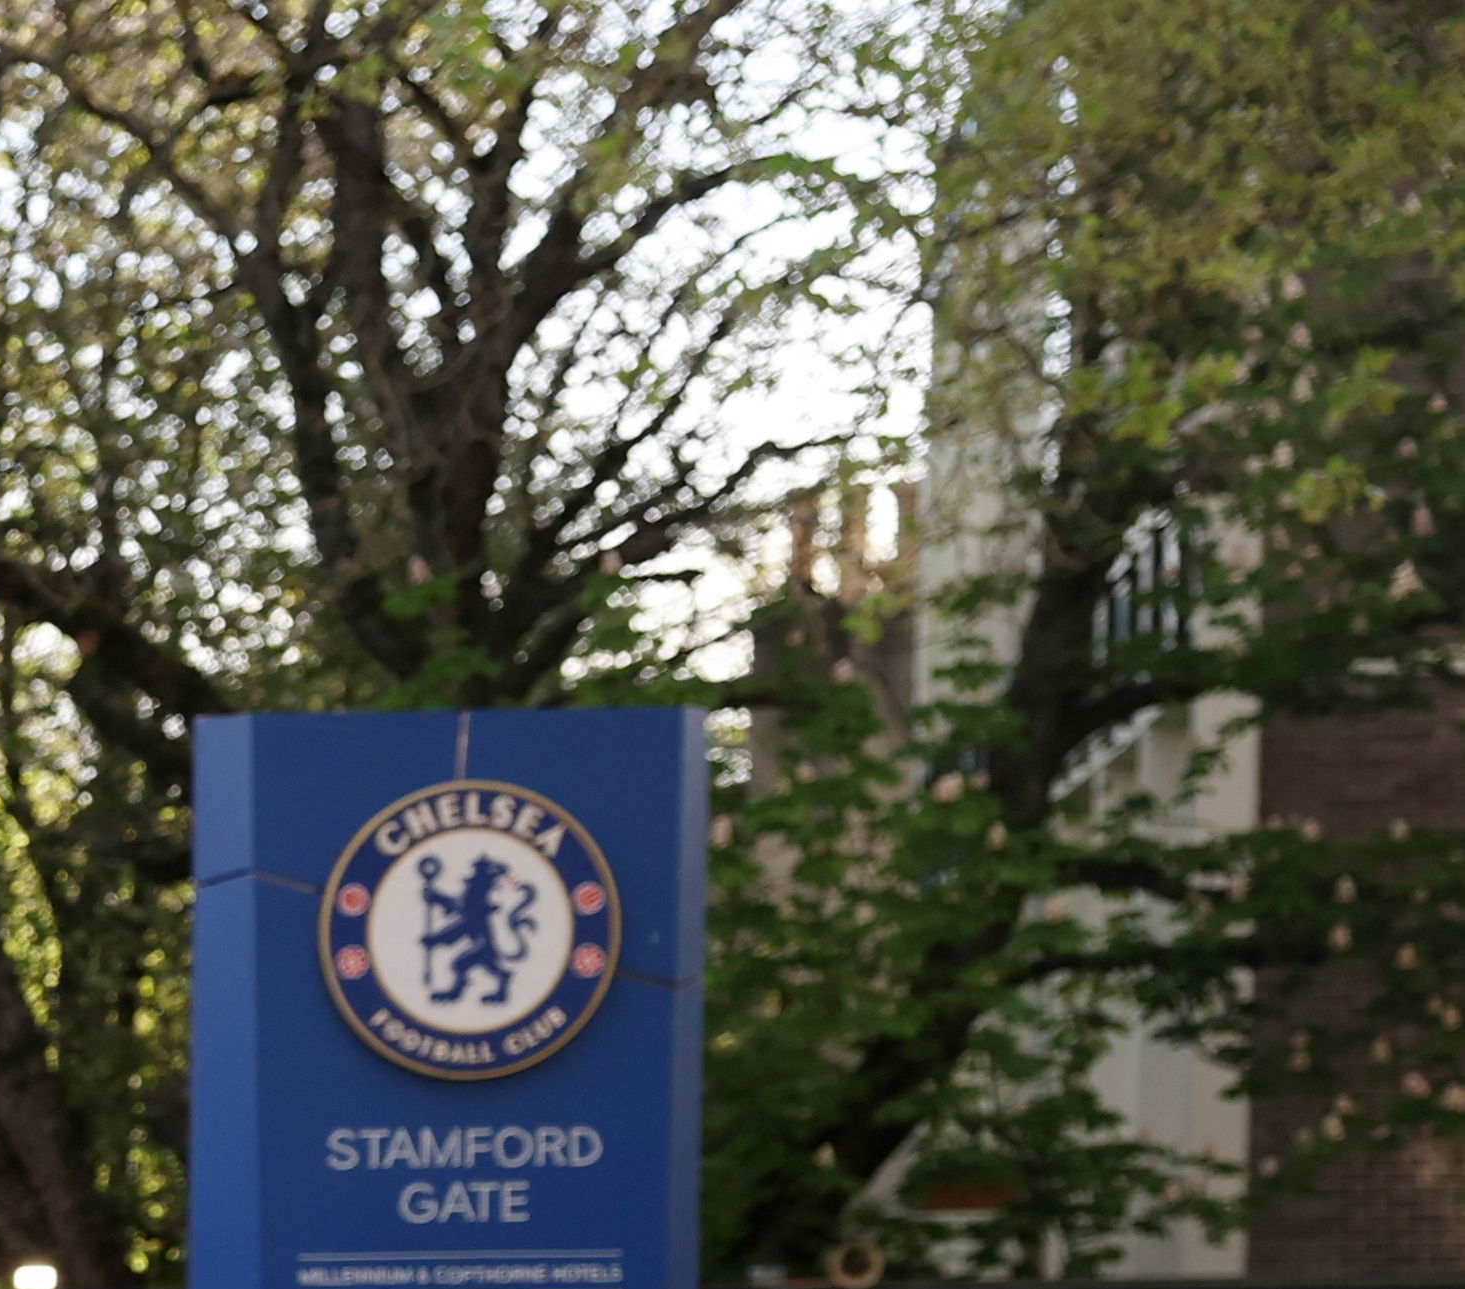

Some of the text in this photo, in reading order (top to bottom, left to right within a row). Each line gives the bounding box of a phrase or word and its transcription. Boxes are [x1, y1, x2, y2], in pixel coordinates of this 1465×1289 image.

[374, 791, 567, 857] CHELSEA
[369, 1006, 567, 1064] FOOTBALL CLUB
[325, 1125, 603, 1170] STAMFORD
[397, 1180, 531, 1224] GATE
[297, 1263, 623, 1286] MILLENNIUM & COPTHORNE HOTELS
